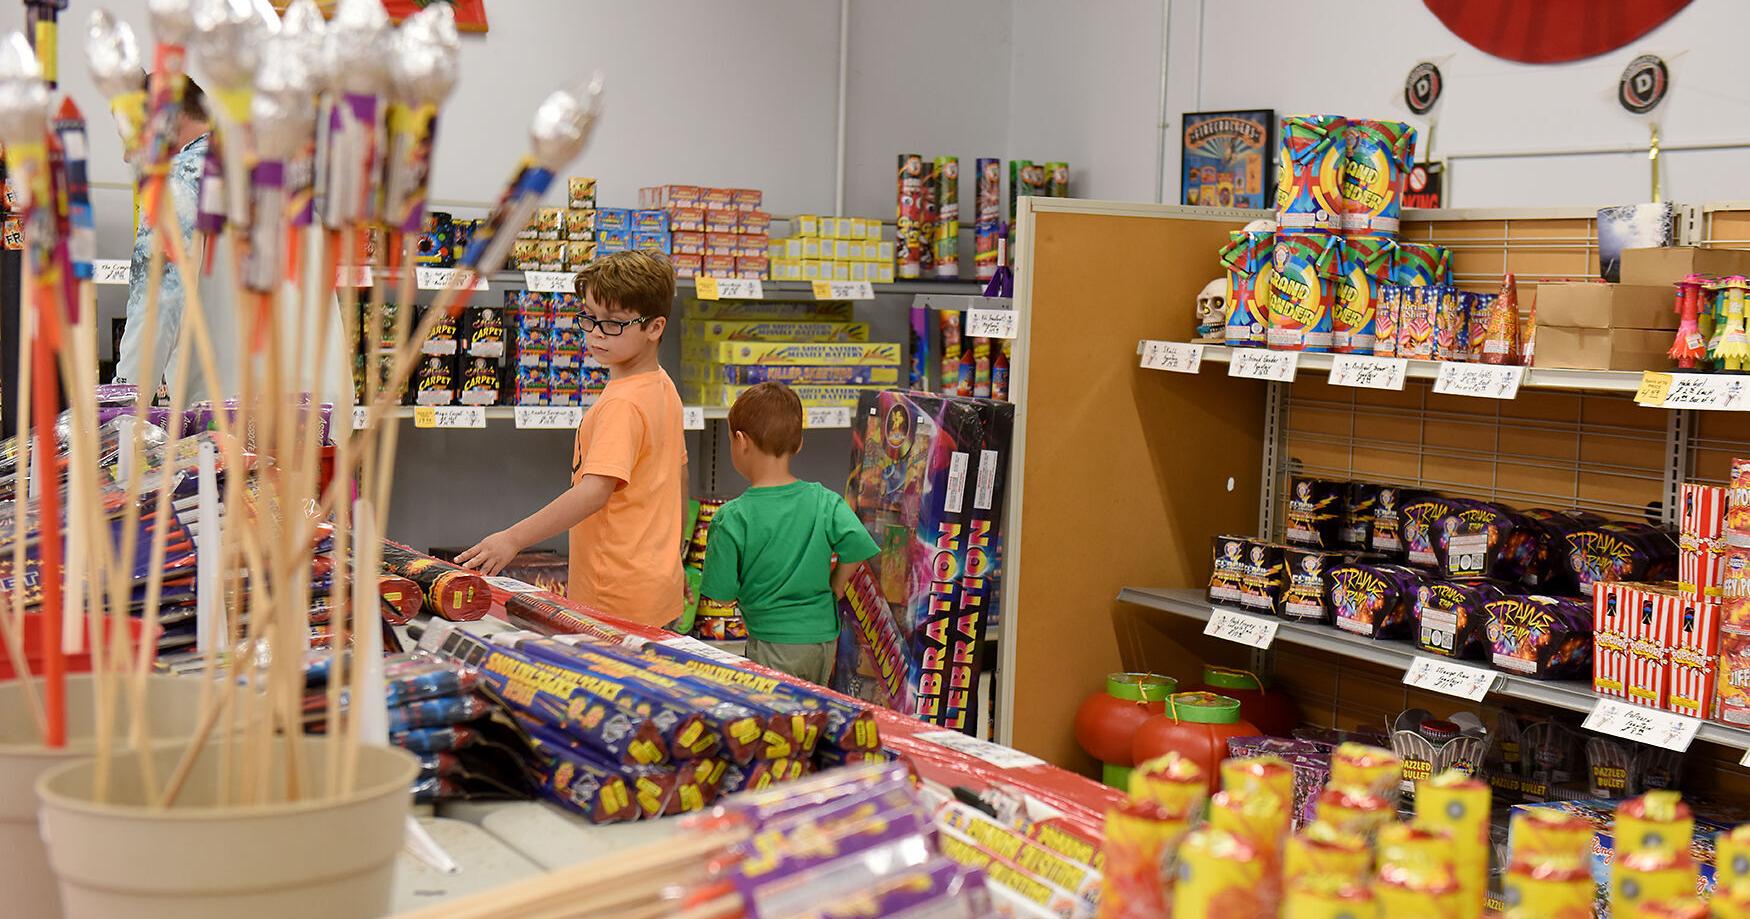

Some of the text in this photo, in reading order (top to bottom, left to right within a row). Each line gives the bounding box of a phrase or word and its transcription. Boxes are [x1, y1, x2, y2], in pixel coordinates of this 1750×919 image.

[471, 326, 503, 343] CARPET
[419, 376, 452, 392] CARPET
[464, 376, 496, 392] CARPET
[1404, 502, 1449, 526] STRAN
[1458, 509, 1498, 525] STRANGE
[1565, 531, 1635, 562] STRANGE
[1586, 554, 1614, 577] RAIN
[1330, 567, 1388, 600] STRANGE
[1344, 588, 1369, 609] RAIN
[1431, 584, 1468, 605] STRANGE
[916, 520, 962, 726] EBRATION
[944, 518, 992, 730] LEBRATION
[1484, 600, 1556, 634] STRANGE
[1503, 624, 1531, 648] RAIN
[1400, 758, 1432, 771] DAZZLED
[1403, 769, 1430, 780] BULLET
[1593, 766, 1627, 778] DAZZLED
[1598, 776, 1625, 789] BULLET
